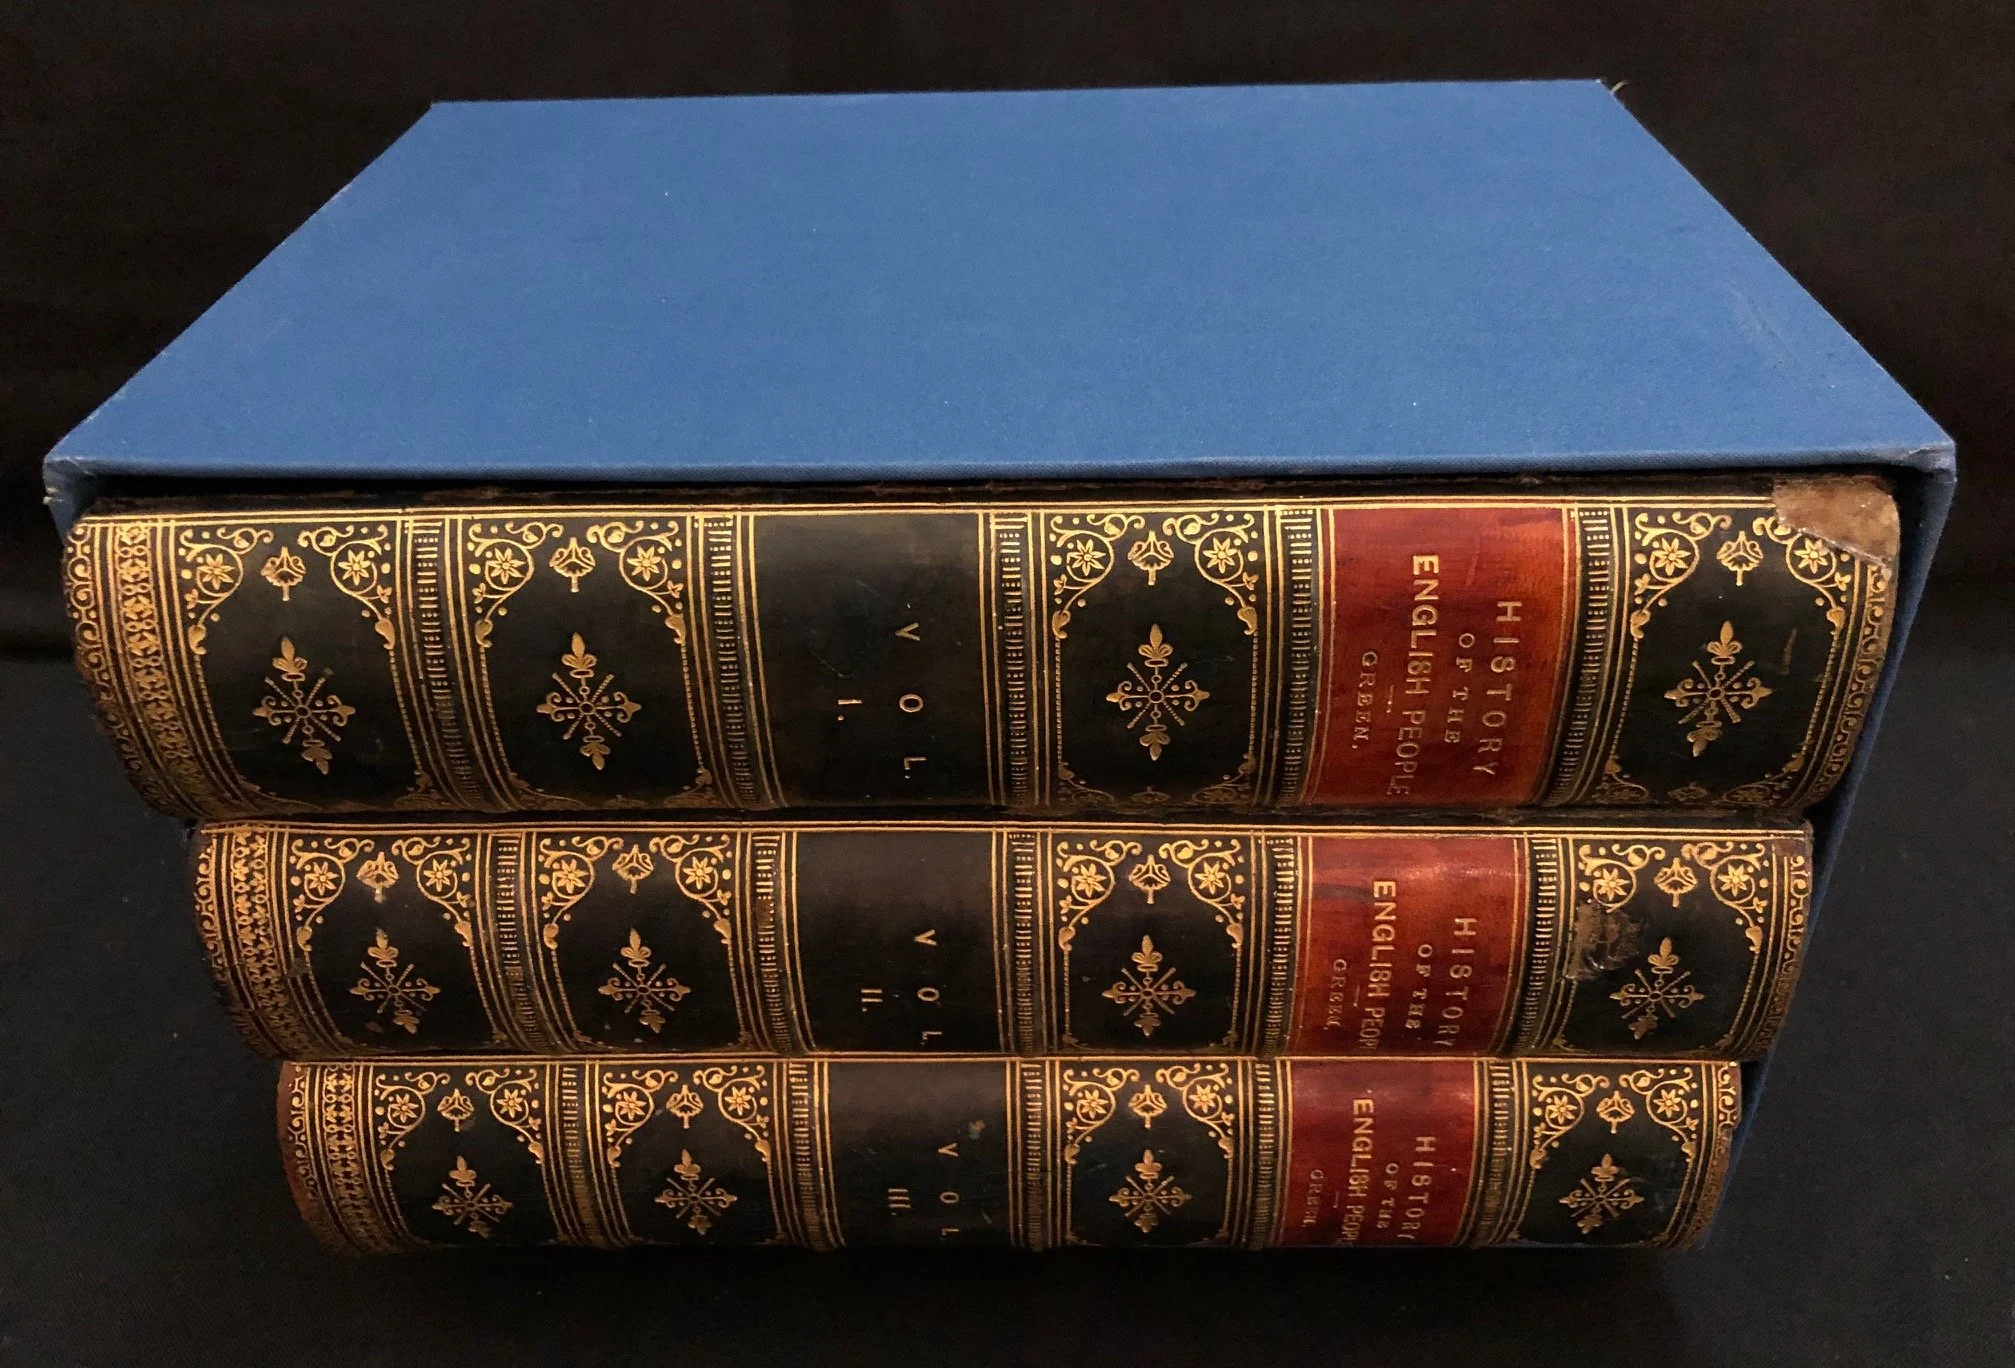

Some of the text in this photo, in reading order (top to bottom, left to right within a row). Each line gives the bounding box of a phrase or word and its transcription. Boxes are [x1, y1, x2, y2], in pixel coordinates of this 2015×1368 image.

[1386, 554, 1440, 796] ENGLISH PEOPLE
[1443, 632, 1476, 744] OF THE
[1472, 600, 1523, 775] HISTORY
[1367, 880, 1398, 998] ENGLISH
[1404, 943, 1434, 1030] OF THE
[1433, 917, 1478, 1047] HISTORY
[1347, 1098, 1375, 1198] ENGLISH
[1376, 1162, 1400, 1230] OF THE
